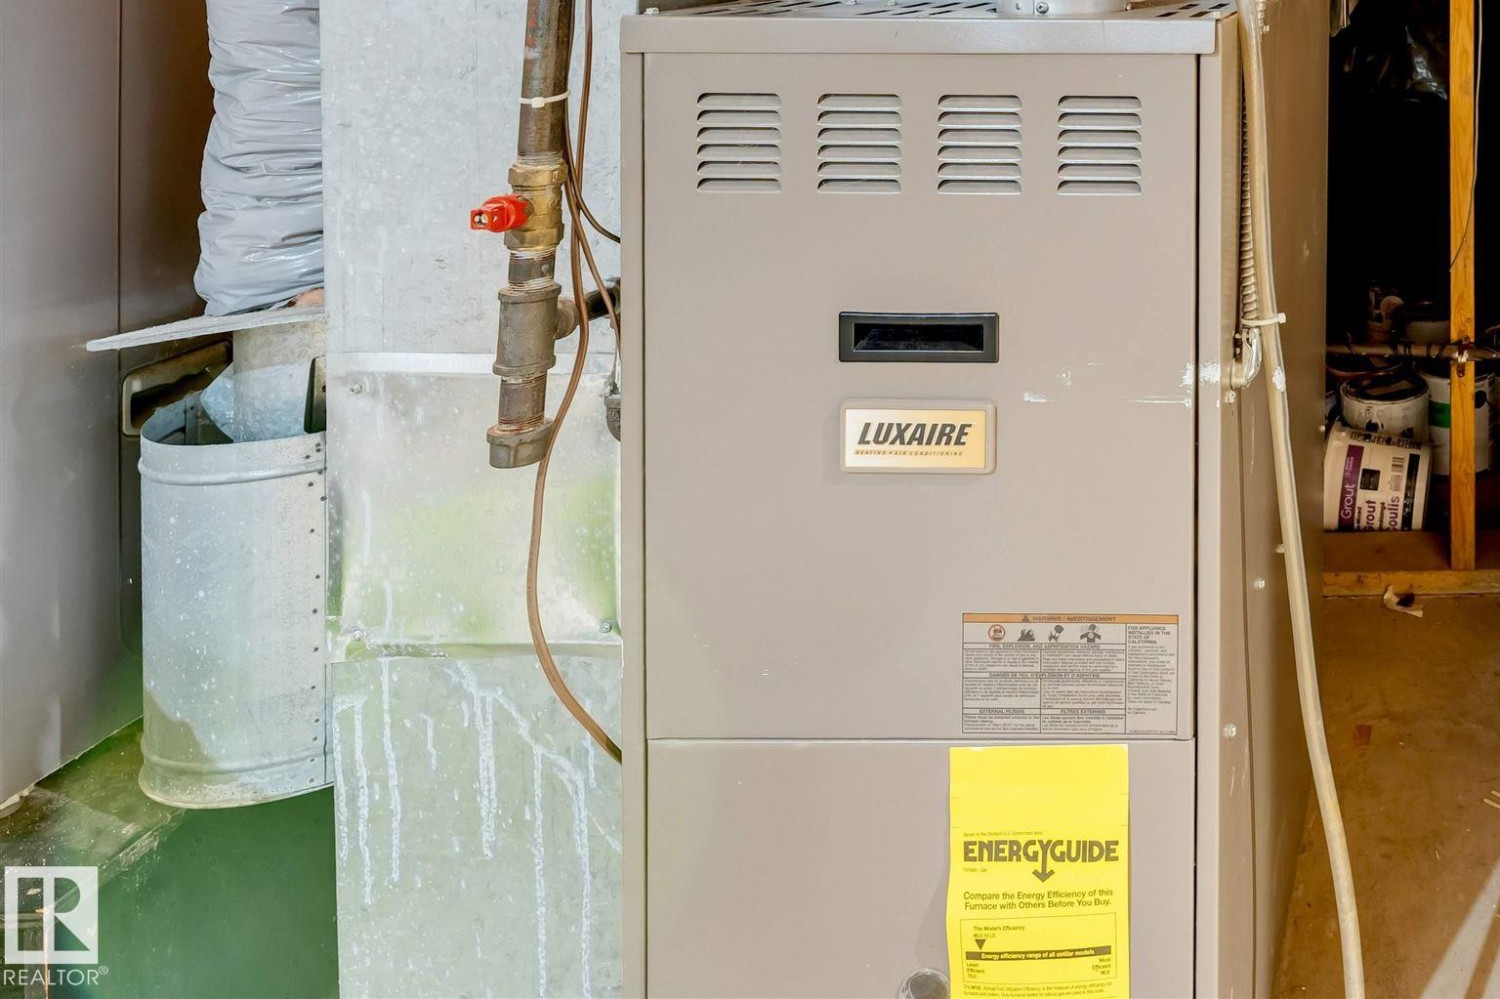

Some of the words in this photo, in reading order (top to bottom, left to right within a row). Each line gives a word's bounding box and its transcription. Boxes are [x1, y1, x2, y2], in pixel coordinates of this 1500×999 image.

[858, 422, 972, 446] LUXAIRE
[1341, 482, 1356, 519] Grout
[964, 840, 1119, 866] ENERGYGUIDE
[964, 892, 999, 900] Compare
[1002, 892, 1014, 900] the
[1017, 892, 1046, 901] Energy
[1047, 891, 1086, 900] Efficiency
[1099, 888, 1113, 896] this
[965, 902, 997, 910] Furnace
[1000, 901, 1016, 909] with
[1019, 900, 1046, 909] Others
[1048, 900, 1074, 908] Before
[1076, 899, 1092, 907] You
[1094, 898, 1111, 907] Buy.
